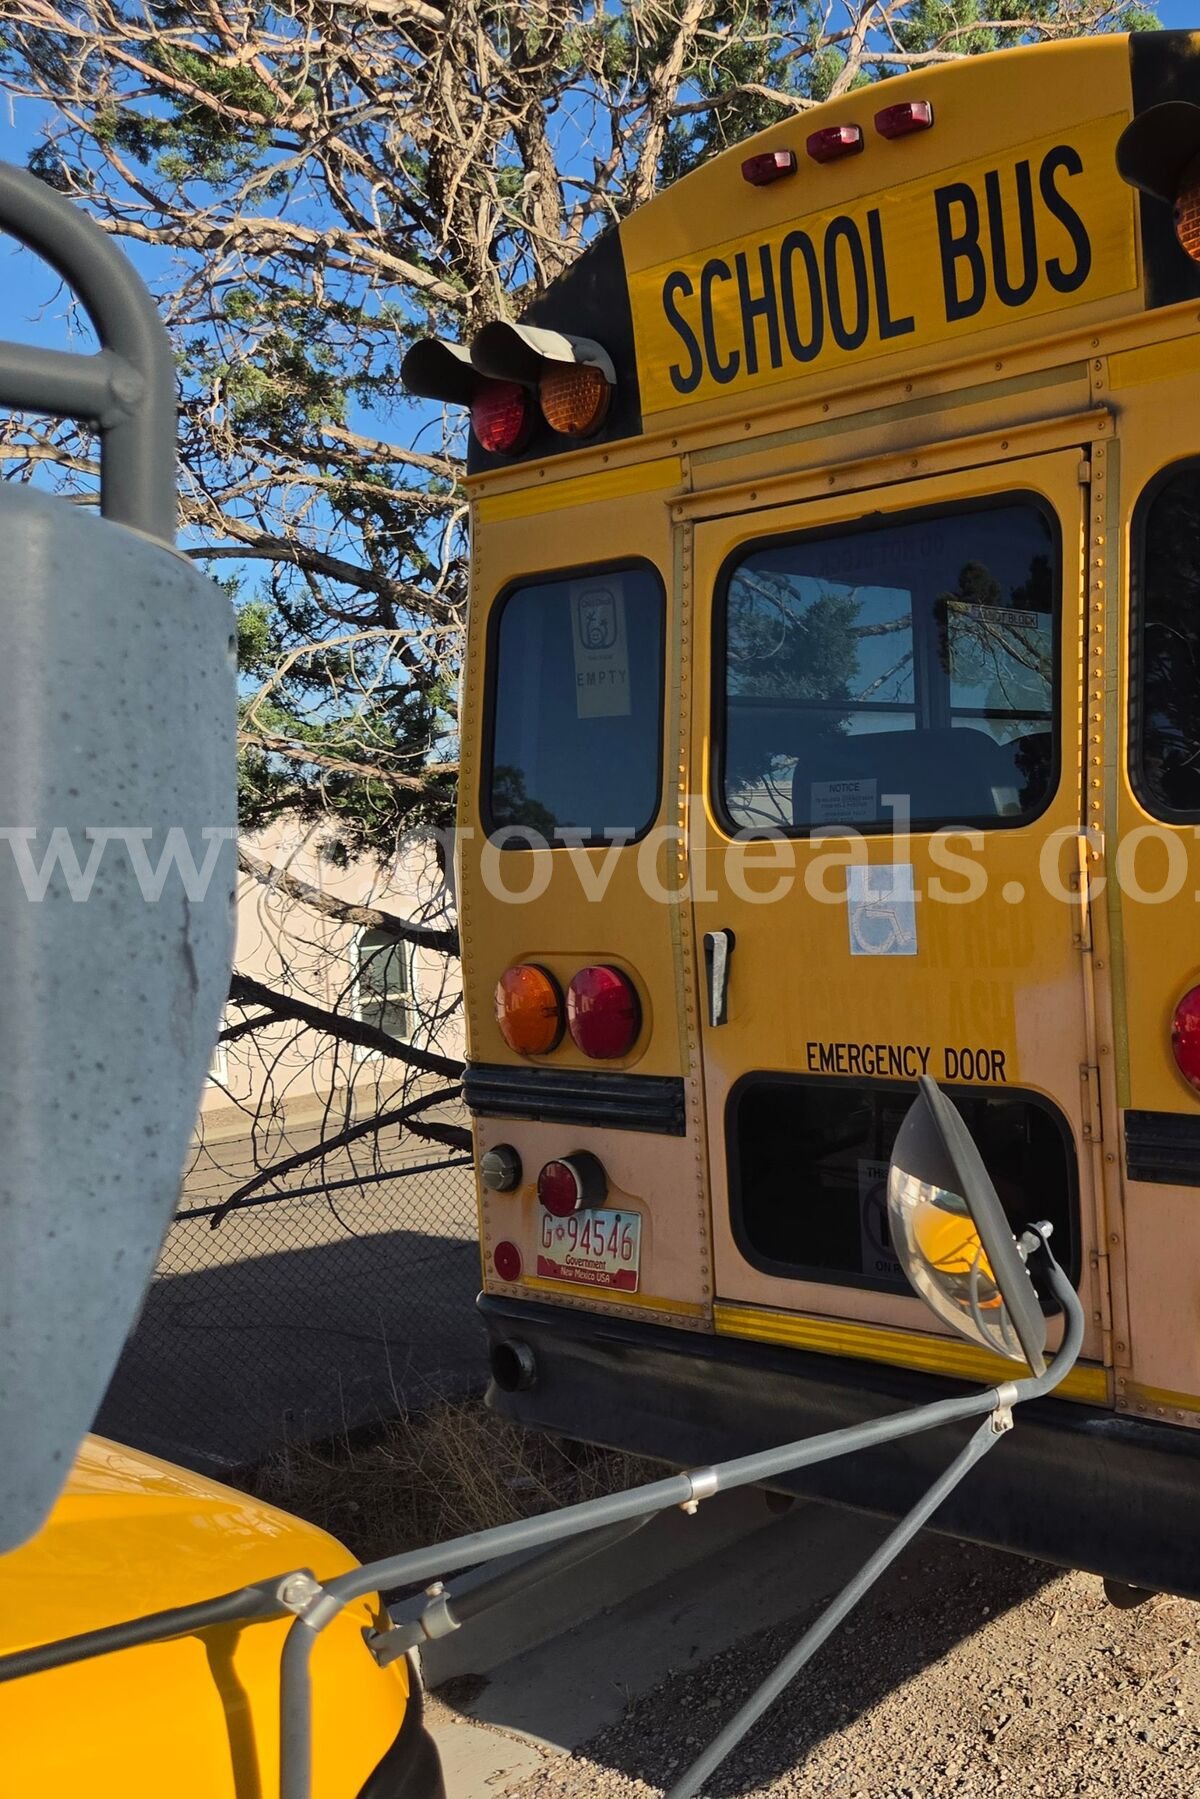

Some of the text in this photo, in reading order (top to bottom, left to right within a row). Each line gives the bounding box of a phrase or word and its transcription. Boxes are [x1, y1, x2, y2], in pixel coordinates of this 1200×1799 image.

[662, 145, 1093, 395] SCHOOL BUS
[577, 669, 627, 688] EMPTY
[829, 782, 860, 793] NOTICE
[806, 1042, 1006, 1082] EMERGENCY DOOR
[565, 1254, 607, 1270] Government
[560, 1266, 610, 1283] New Mexico USA
